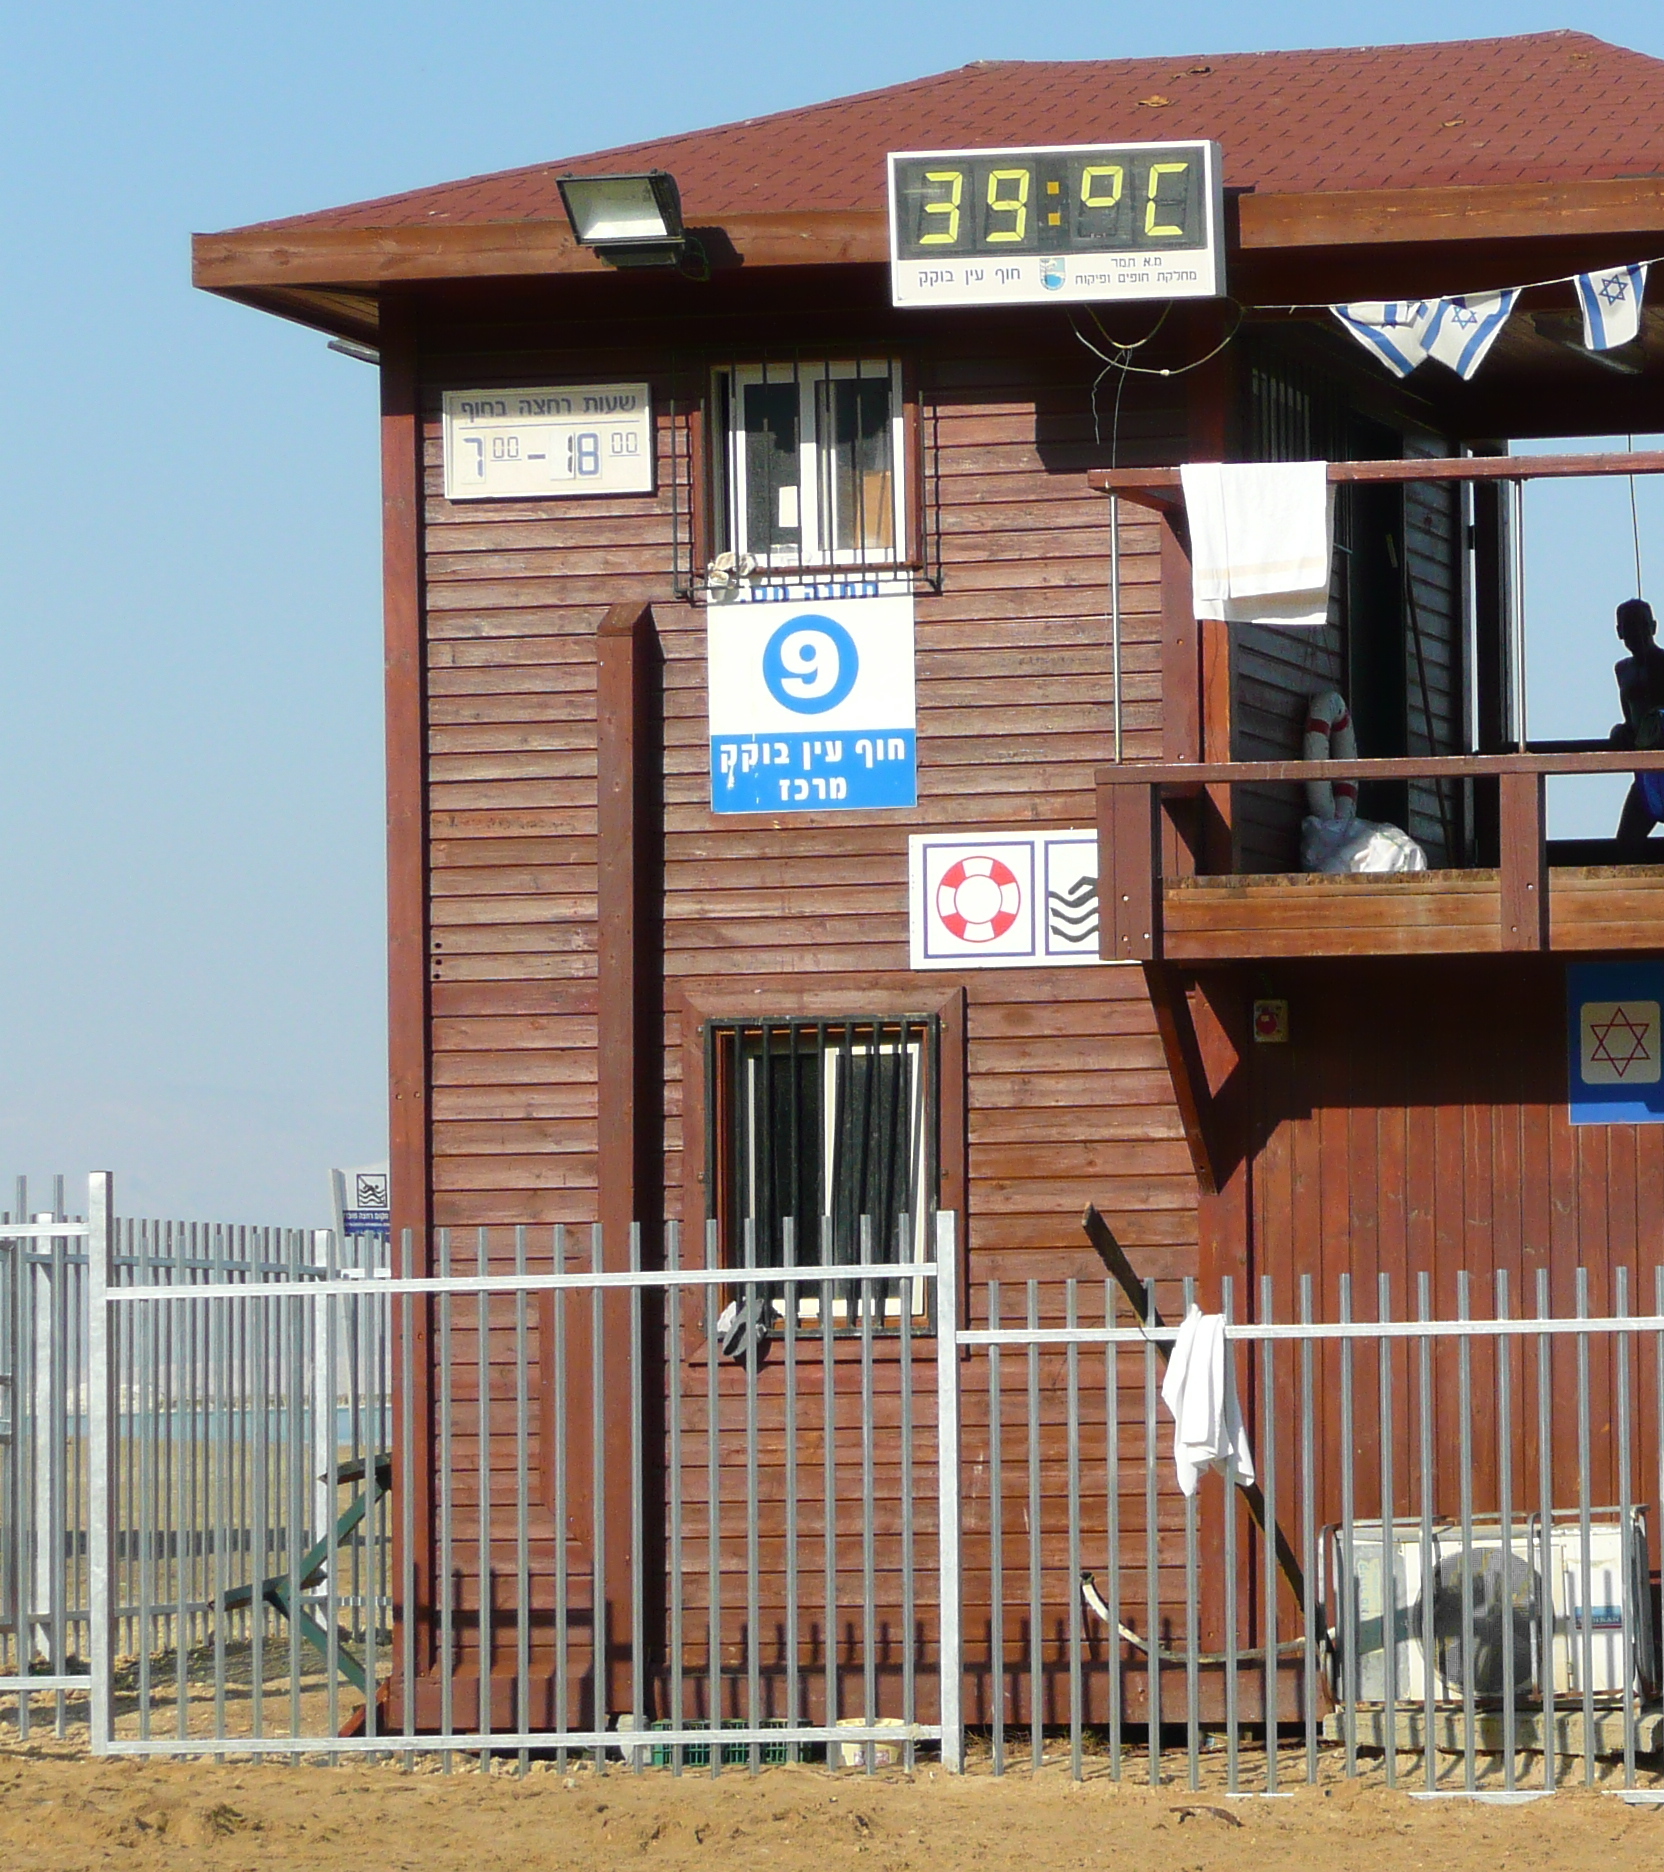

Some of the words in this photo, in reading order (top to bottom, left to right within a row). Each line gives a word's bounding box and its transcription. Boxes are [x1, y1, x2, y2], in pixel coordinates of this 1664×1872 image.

[1111, 258, 1136, 268] תמר
[918, 270, 954, 287] בוקק
[965, 269, 984, 286] עין
[995, 268, 1021, 284] חוף
[1075, 274, 1110, 286] ופיקוח
[1118, 273, 1149, 283] חופים
[1157, 271, 1197, 284] מחלקת
[460, 400, 507, 423] בחוף
[518, 397, 572, 415] רחצה
[582, 394, 637, 412] שעות
[780, 629, 840, 699] 9
[720, 742, 790, 774] בוקק
[802, 740, 842, 771] עין
[854, 738, 905, 768] חוף
[779, 777, 847, 801] מרכז
